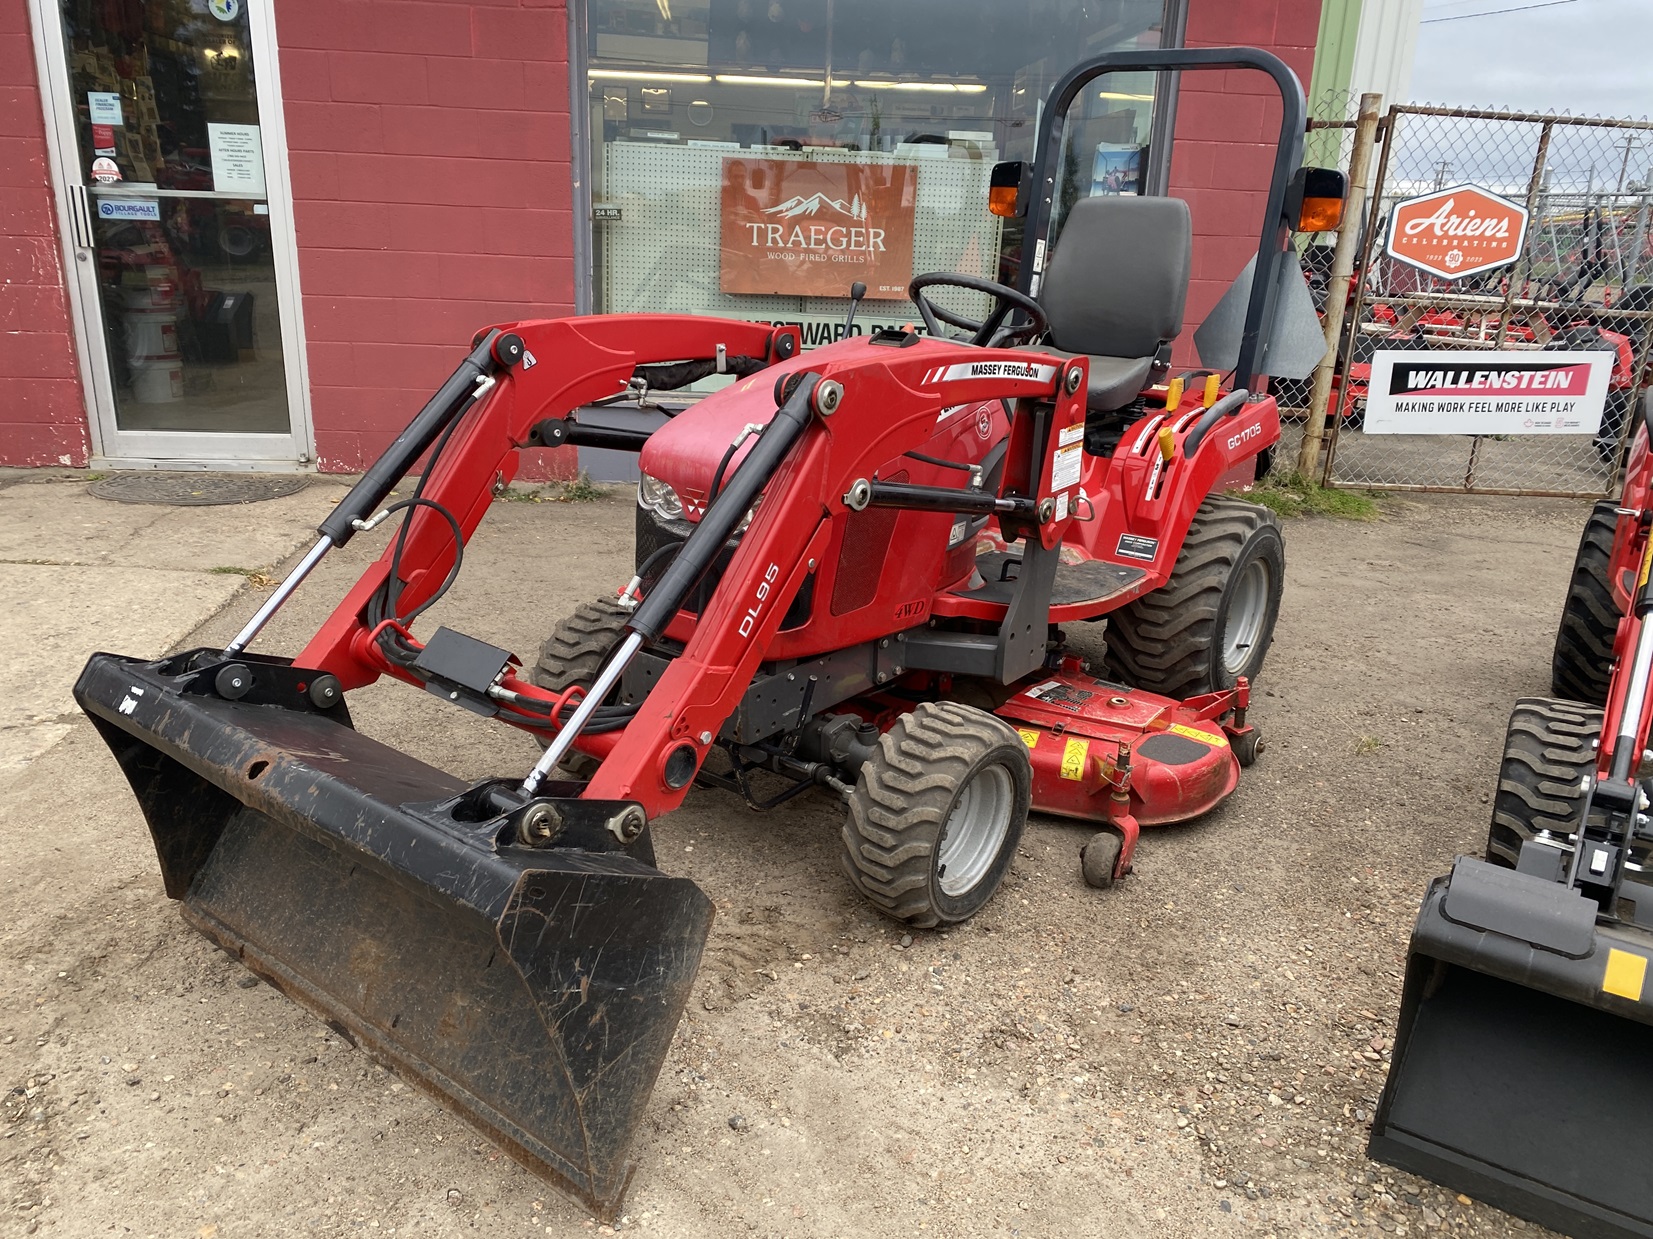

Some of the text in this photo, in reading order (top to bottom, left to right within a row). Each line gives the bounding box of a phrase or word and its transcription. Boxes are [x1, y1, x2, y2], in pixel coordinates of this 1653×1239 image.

[1404, 198, 1509, 238] Ariens
[746, 223, 886, 251] TRAEGER
[1402, 237, 1508, 248] CELEBRATING
[767, 252, 864, 263] WOOD FIRED GRILLS
[1449, 253, 1460, 262] 90
[747, 320, 862, 346] WARD
[971, 365, 1039, 378] MASSEY FERGUSON
[1407, 370, 1573, 389] WALLENSTEIN
[1395, 401, 1576, 413] MAKING WORK FEEL MORE LIKE PLAY
[738, 562, 779, 638] DL95
[895, 601, 925, 618] 4WD
